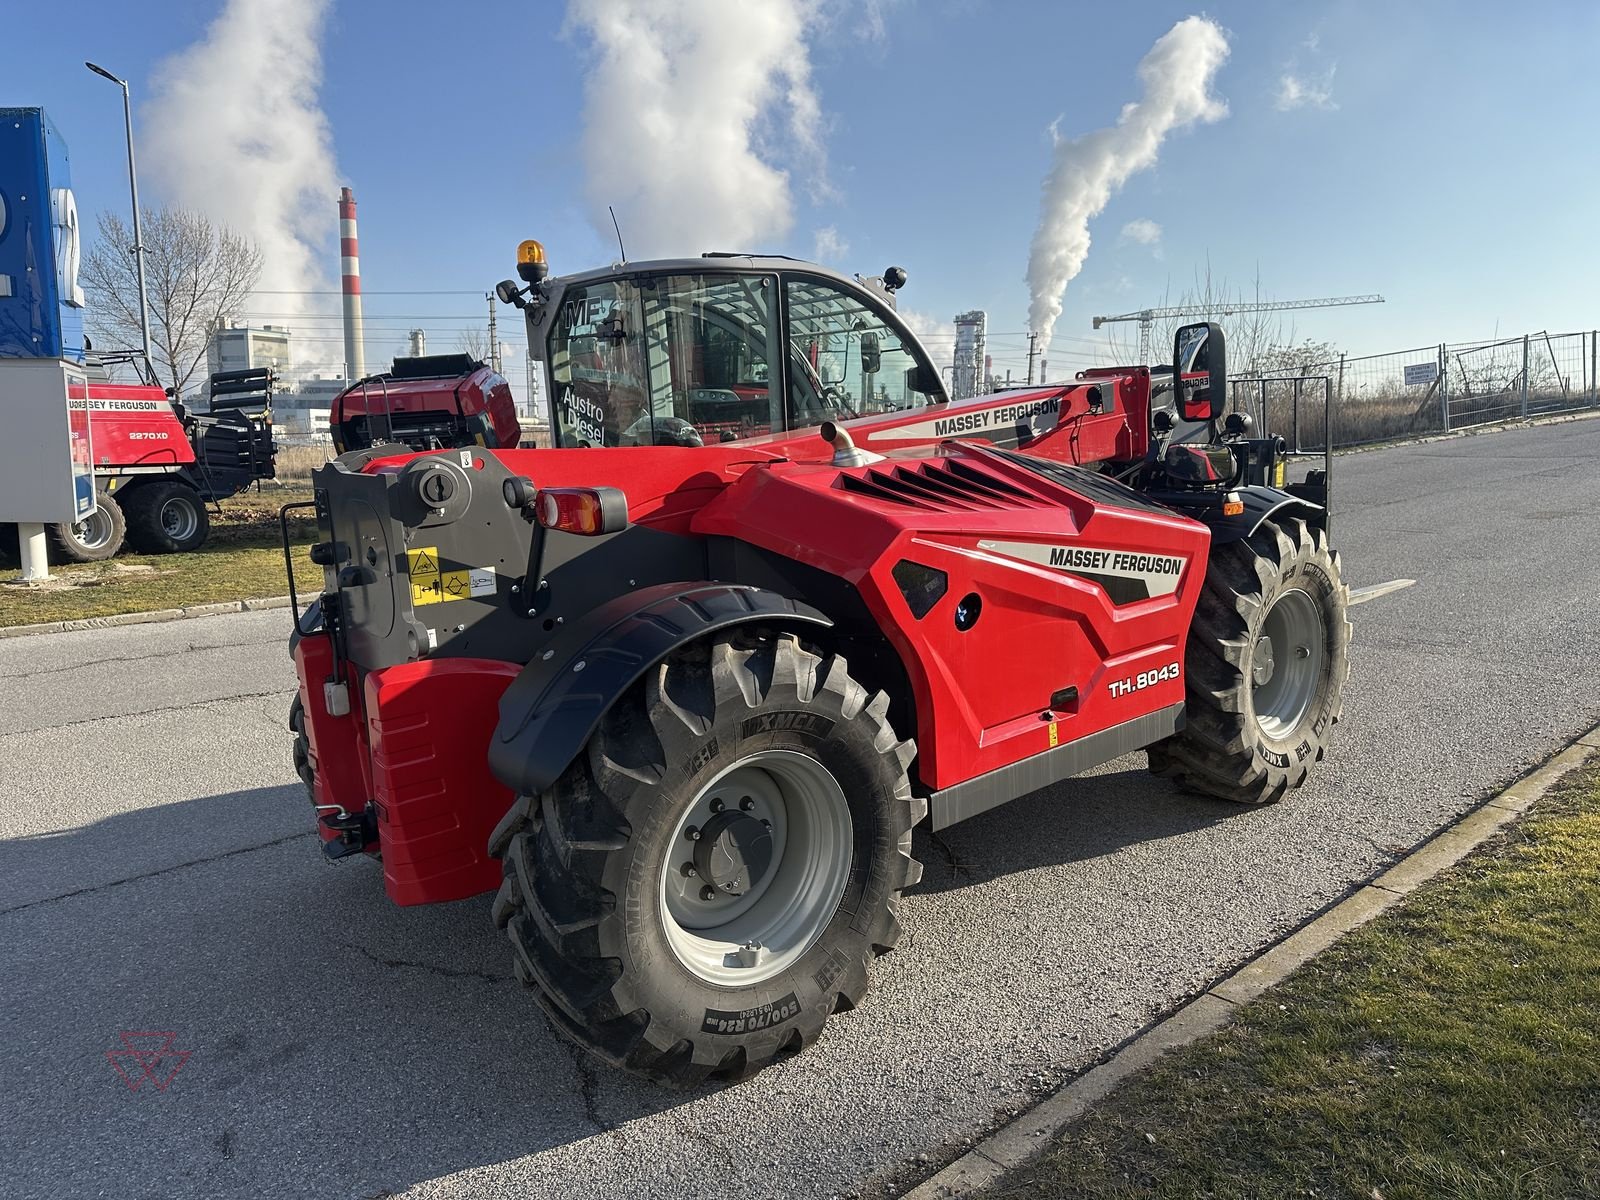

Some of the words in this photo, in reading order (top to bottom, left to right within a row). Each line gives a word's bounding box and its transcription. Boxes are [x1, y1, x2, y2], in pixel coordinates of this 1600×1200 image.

[109, 401, 157, 410] FERGUSON
[563, 386, 604, 422] Austro
[935, 412, 990, 437] MASSEY
[993, 399, 1059, 424] FERGUSON
[567, 408, 605, 445] Diesel
[1050, 548, 1111, 569] MASSEY
[1112, 553, 1182, 575] FERGUSON
[1108, 662, 1180, 699] TH.8043
[717, 1019, 746, 1033] R24
[748, 1001, 798, 1030] 500/70
